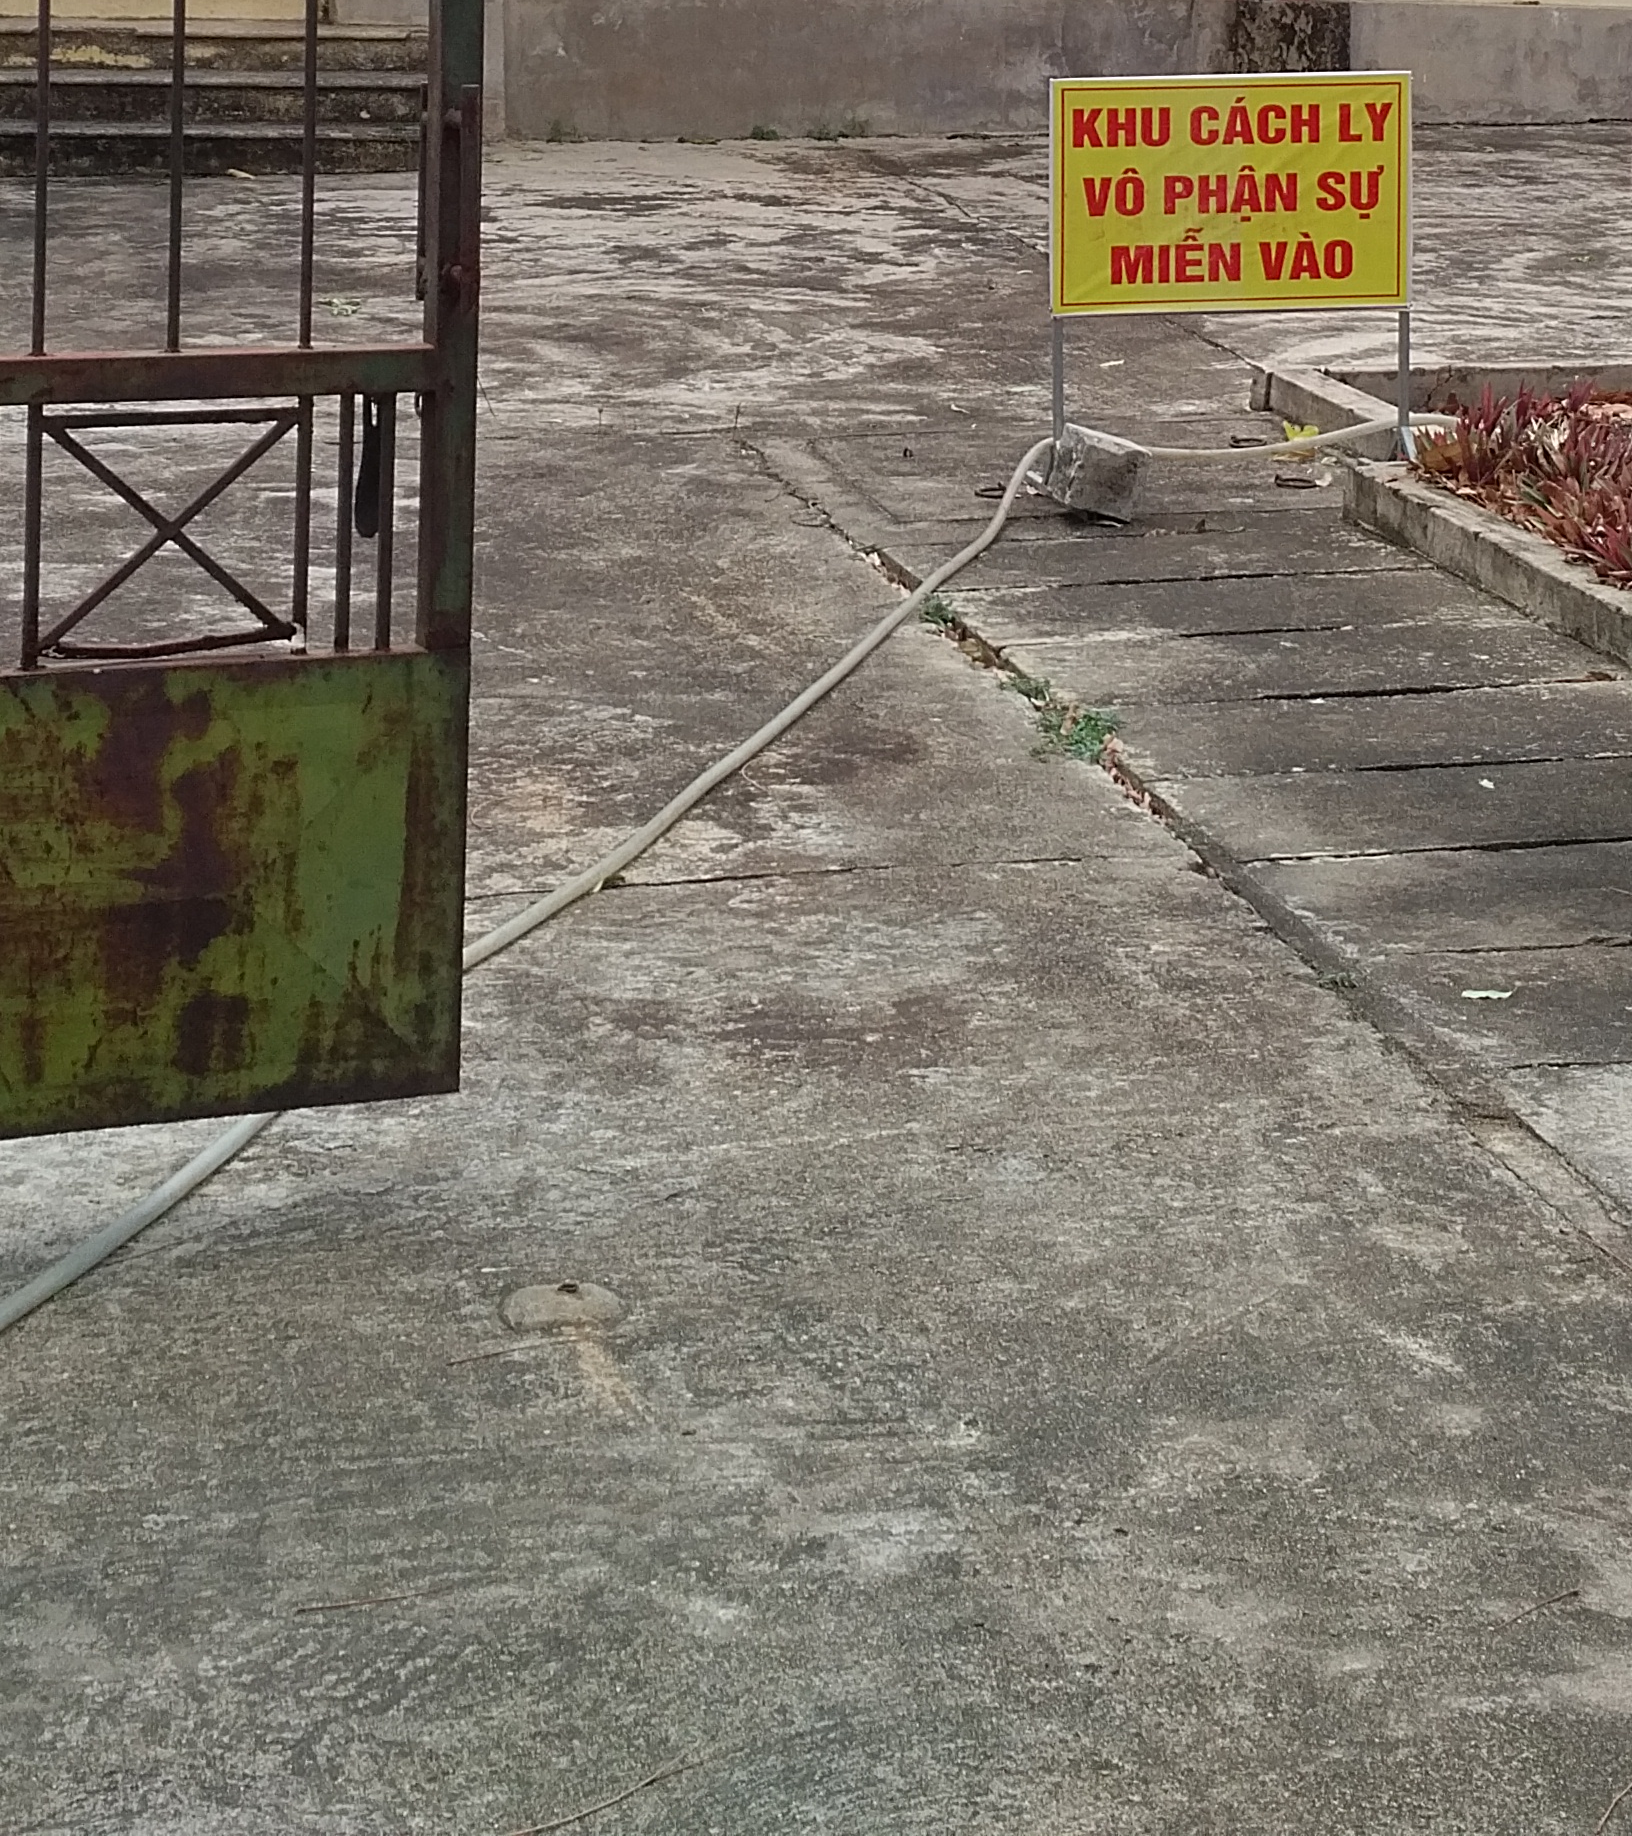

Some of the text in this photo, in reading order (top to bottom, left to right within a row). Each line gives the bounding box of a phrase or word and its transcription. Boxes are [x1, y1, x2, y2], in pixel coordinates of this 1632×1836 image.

[1071, 96, 1393, 149] KHU CÁCH LY
[1082, 164, 1384, 222] VÔ PHẬN SỰ
[1110, 227, 1354, 285] MIỄN VÀO
